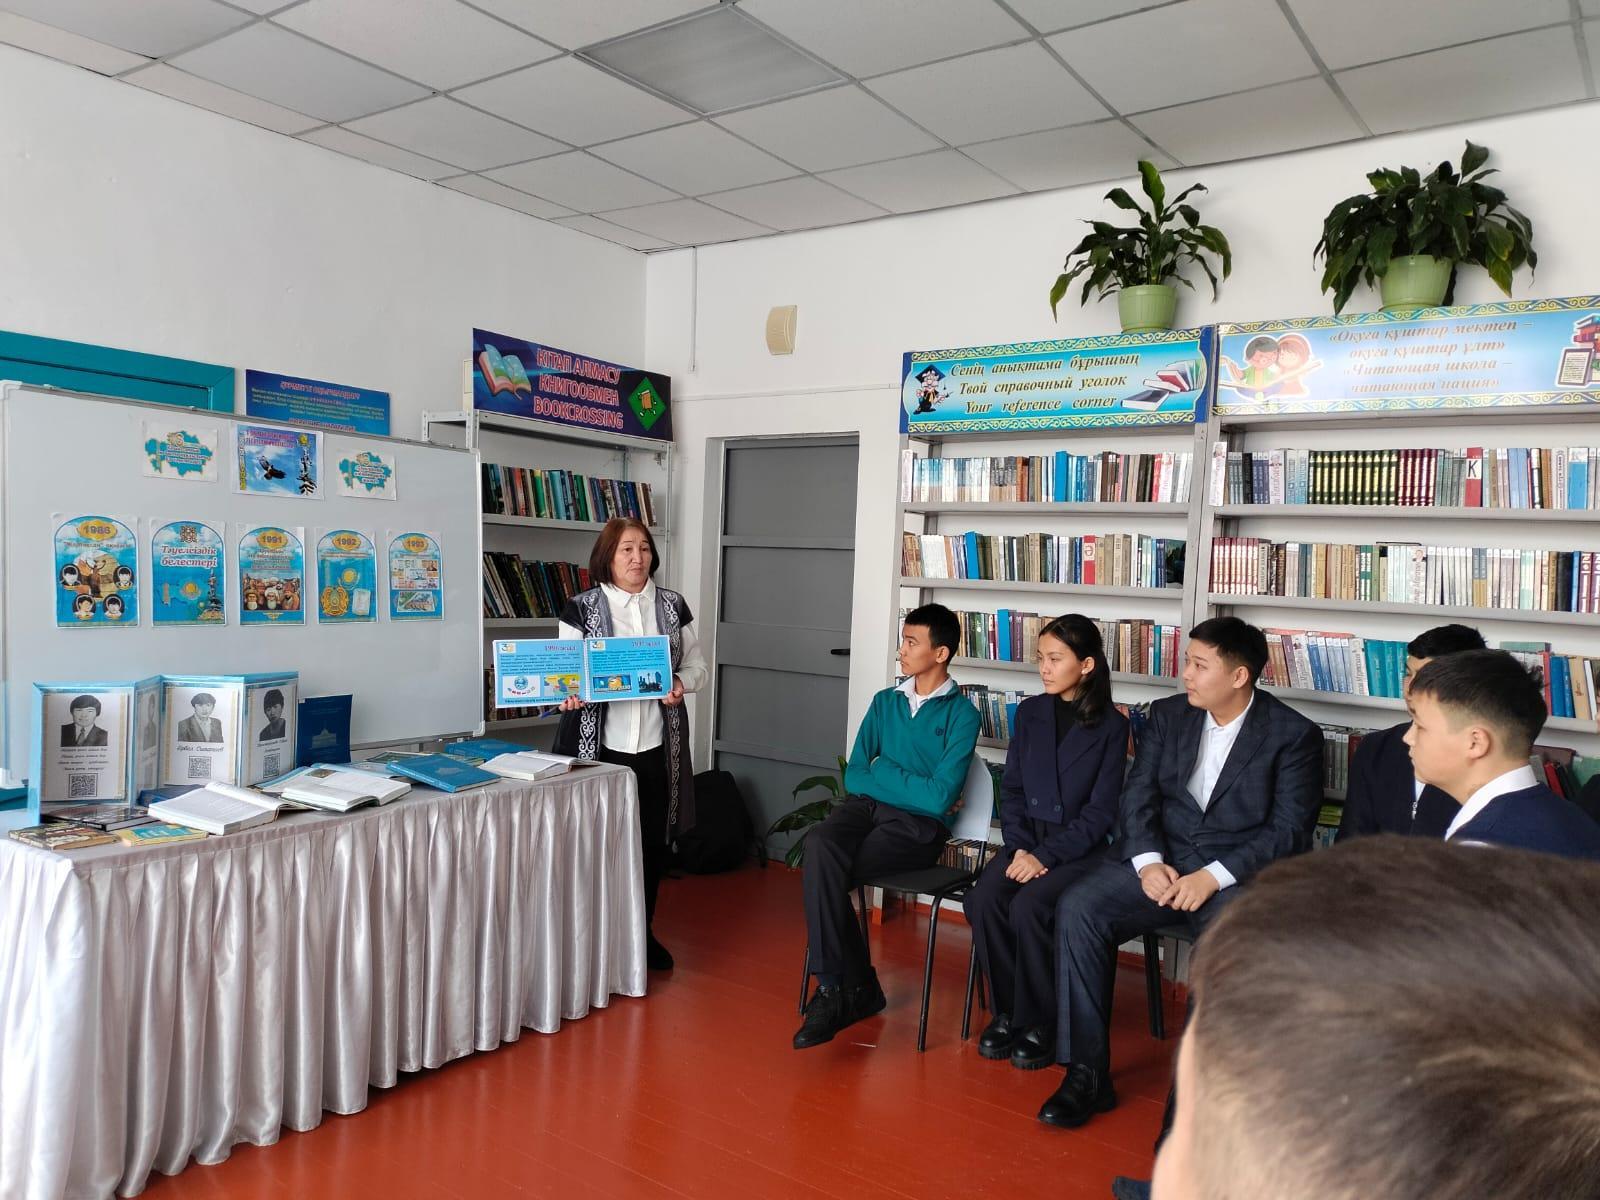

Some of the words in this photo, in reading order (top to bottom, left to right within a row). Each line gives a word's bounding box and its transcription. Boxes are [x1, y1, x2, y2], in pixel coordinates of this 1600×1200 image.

[1452, 320, 1517, 334] мектеп
[537, 348, 571, 374] КІТАП
[573, 356, 621, 385] АЛМАСУ
[951, 361, 985, 378] Сенің
[991, 358, 1062, 376] анықтама
[1070, 353, 1140, 372] бұрышың
[1445, 358, 1497, 372] школа
[539, 373, 620, 406] КНИГООБМЕН
[959, 381, 988, 395] Твой
[994, 377, 1073, 395] справочный
[1079, 374, 1128, 392] уголок
[1351, 380, 1435, 395] читающая
[1440, 377, 1500, 392] нация»
[534, 396, 624, 430] BOOKCROSSING
[966, 401, 993, 414] Your
[1003, 399, 1062, 416] reference
[1072, 397, 1117, 410] corner
[84, 525, 112, 535] 1986
[262, 535, 283, 544] 1991
[336, 537, 357, 546] 1992
[407, 540, 425, 549] 1993
[162, 545, 217, 556] Тәуелсіздік
[161, 556, 218, 570] белестері
